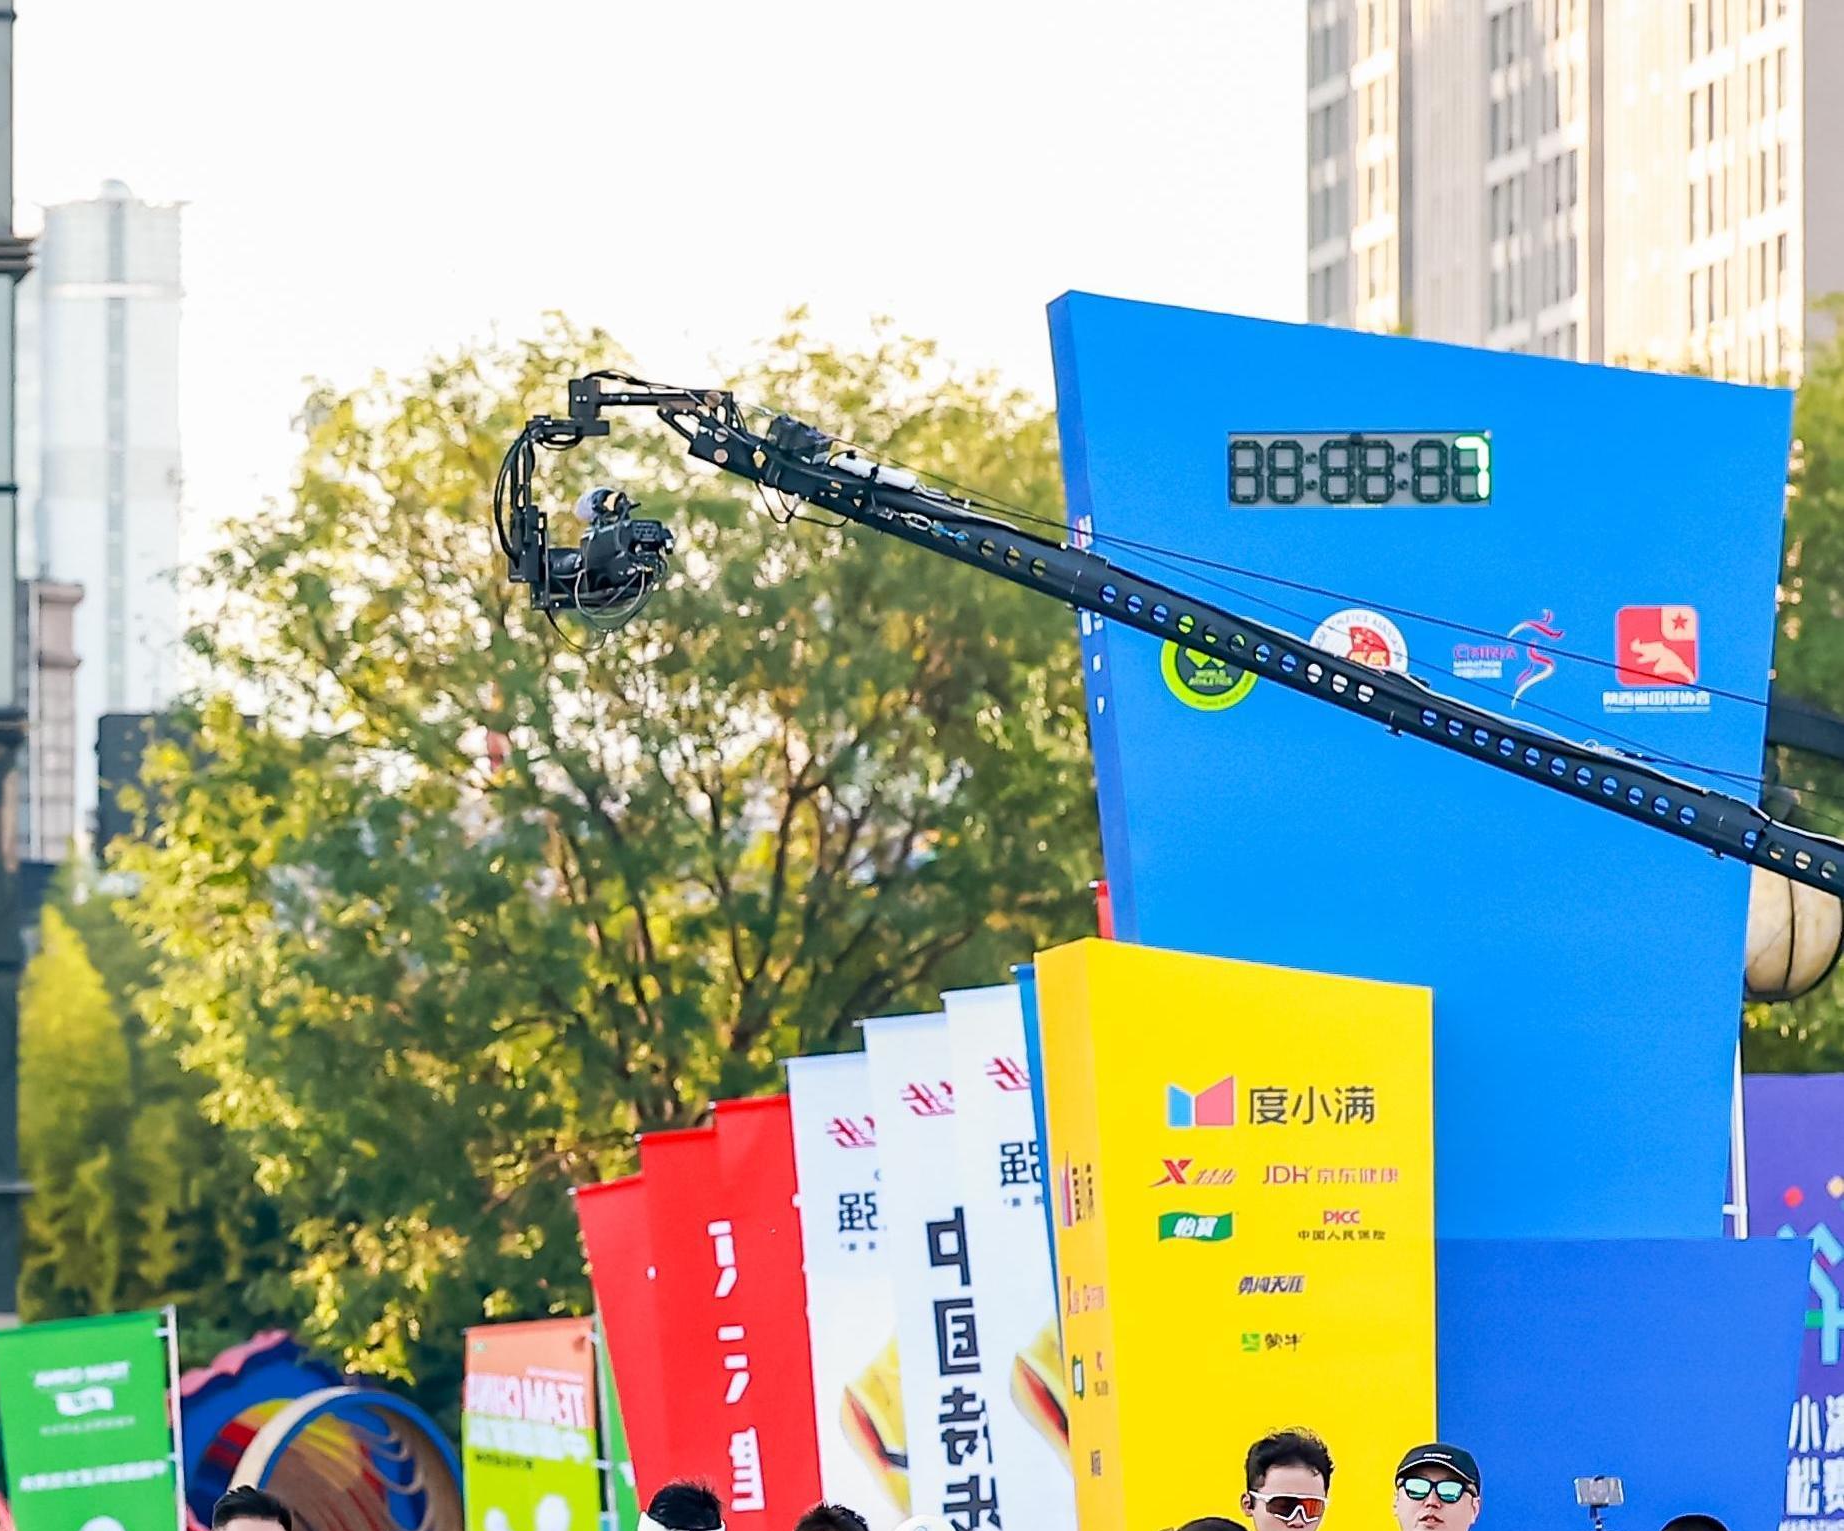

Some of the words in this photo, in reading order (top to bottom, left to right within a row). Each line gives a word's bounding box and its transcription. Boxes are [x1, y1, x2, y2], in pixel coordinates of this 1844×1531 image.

[1454, 645, 1516, 660] CHINA
[1249, 1086, 1375, 1126] 度小满
[1323, 1210, 1360, 1224] PICC
[1298, 1229, 1386, 1241] 中国人民保险
[1237, 1275, 1305, 1295] 勇闯天涯
